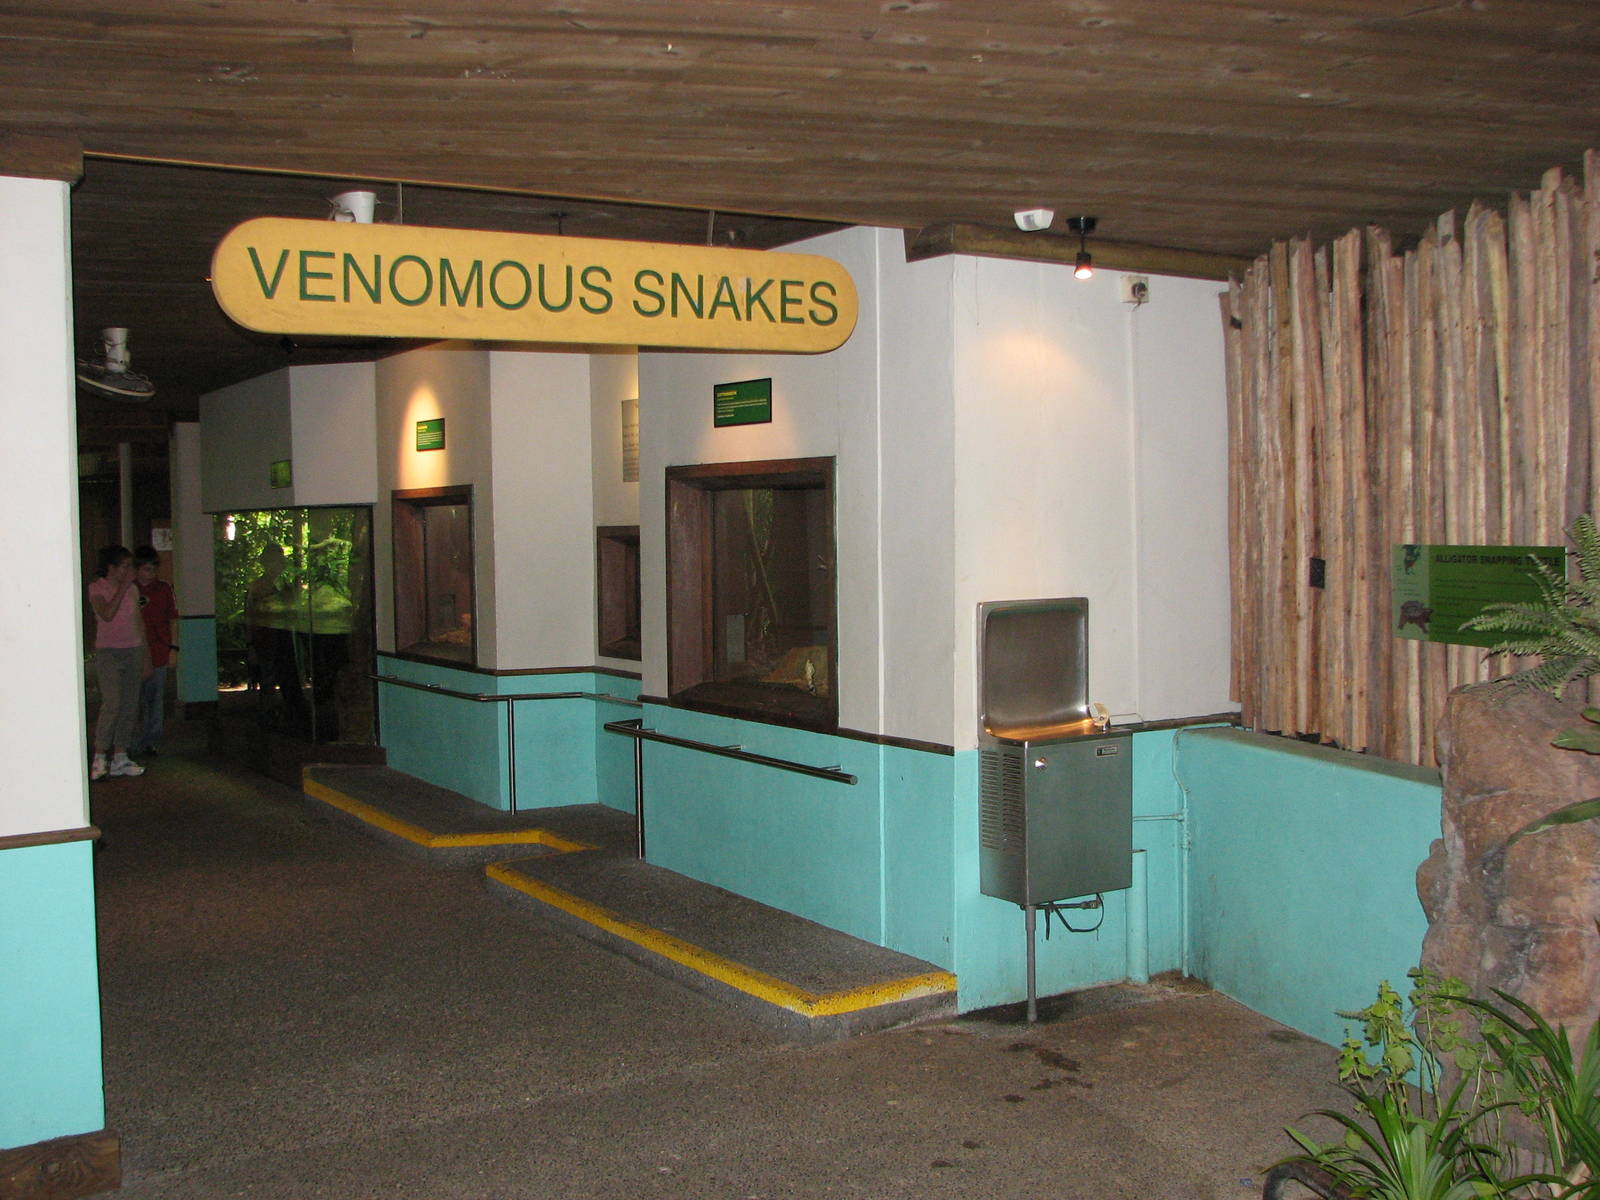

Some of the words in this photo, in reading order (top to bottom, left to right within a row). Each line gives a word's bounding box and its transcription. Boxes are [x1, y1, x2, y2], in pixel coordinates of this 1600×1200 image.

[247, 247, 614, 312] VENOMOUS
[632, 269, 839, 327] SNAKES
[1435, 554, 1478, 564] ALLIGATOR
[1480, 555, 1521, 566] SNAPPING
